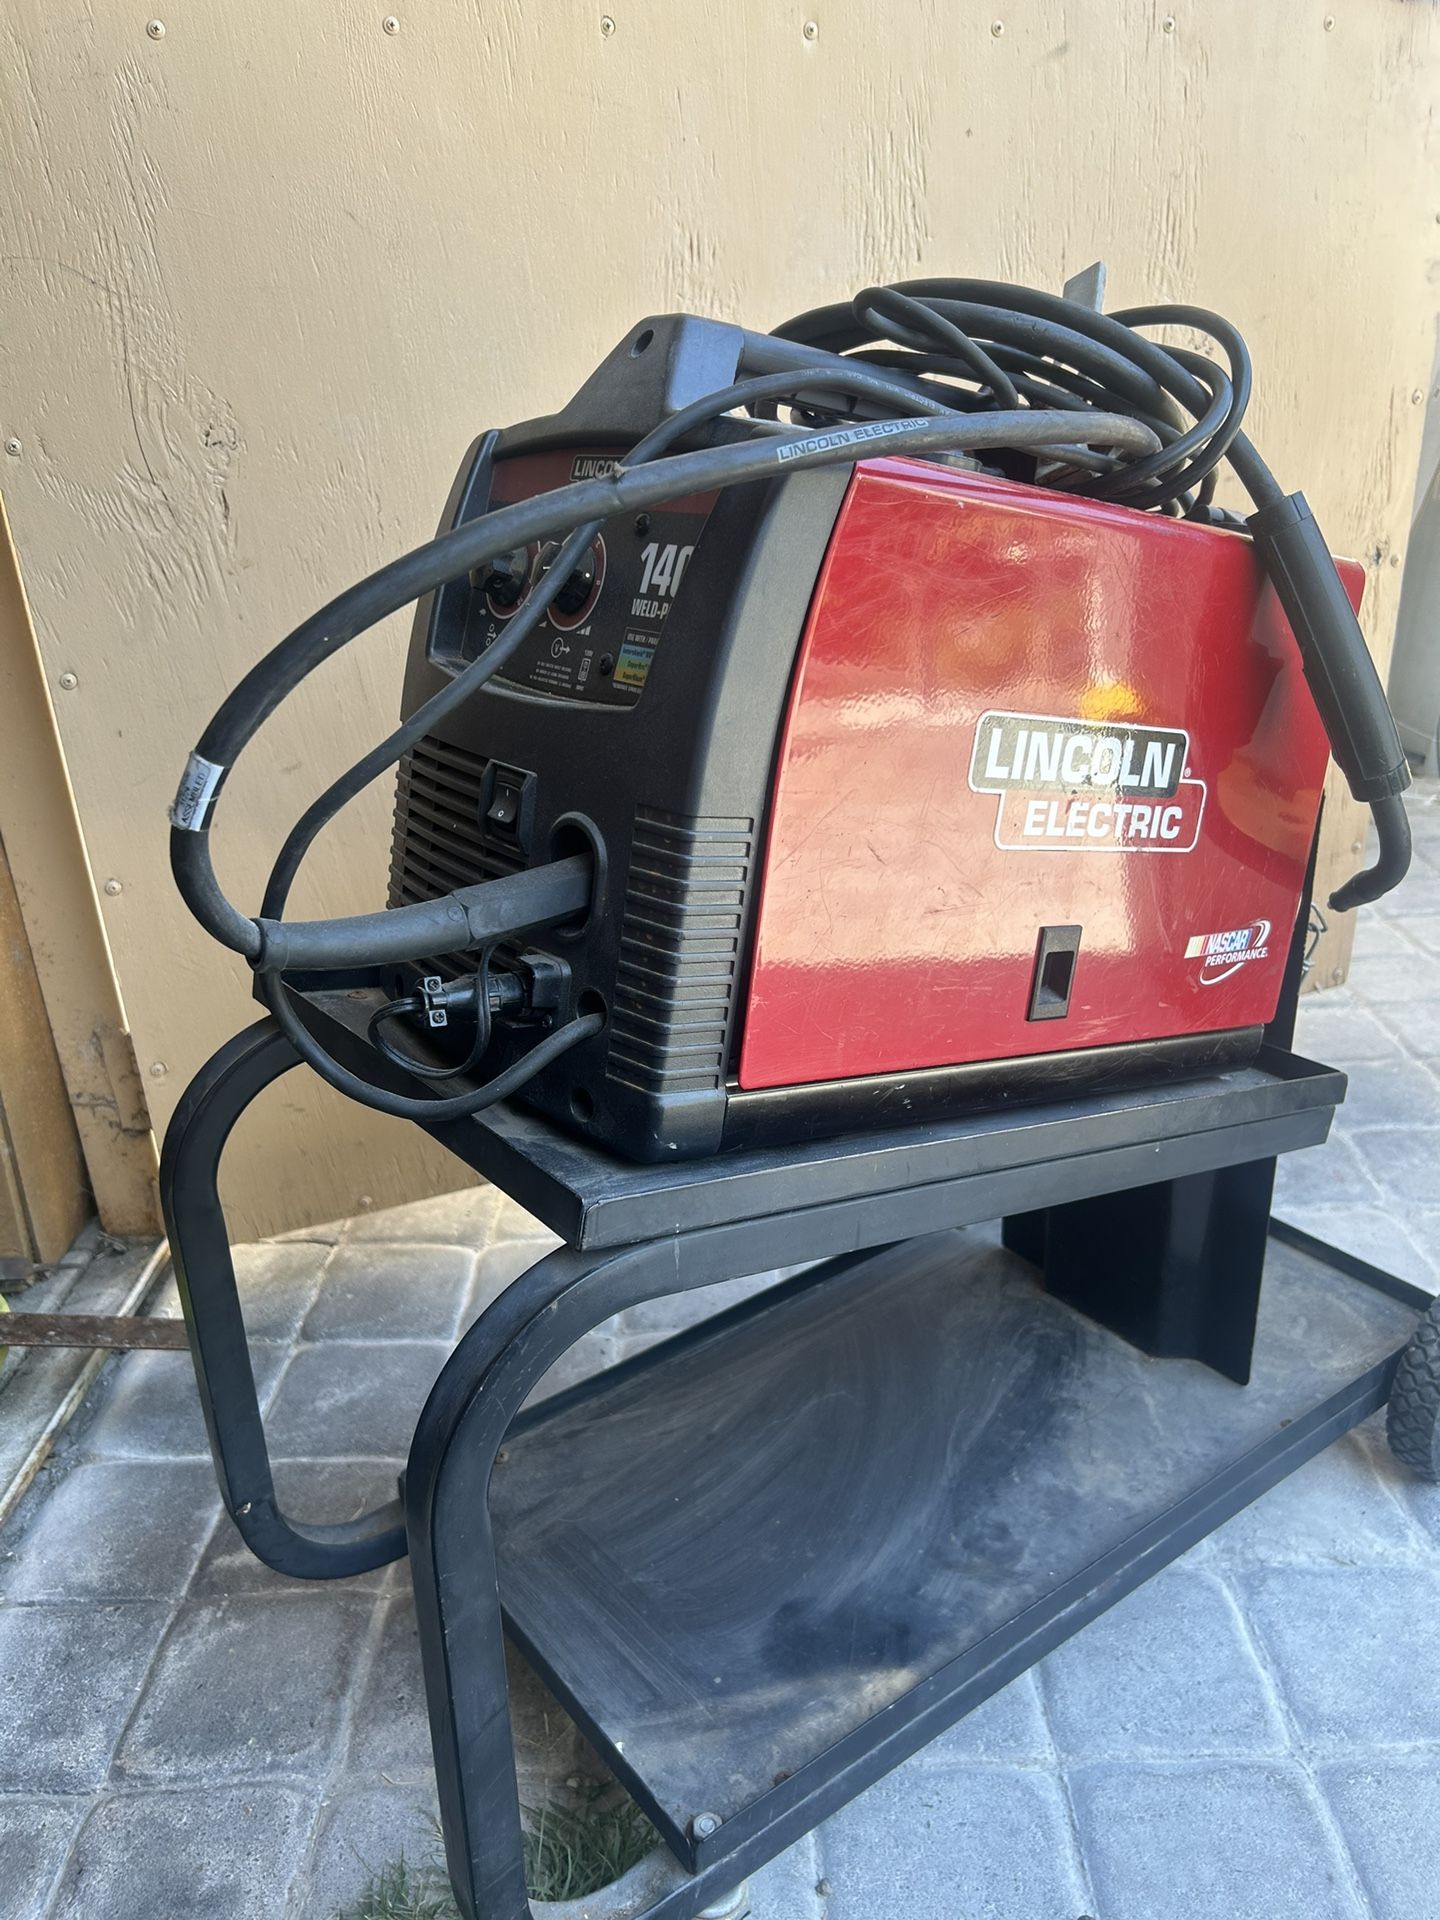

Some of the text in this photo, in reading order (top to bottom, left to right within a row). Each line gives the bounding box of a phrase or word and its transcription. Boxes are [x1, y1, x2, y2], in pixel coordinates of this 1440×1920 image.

[779, 419, 927, 460] LINCOLN ELECTRIC
[574, 459, 615, 479] LINCO
[631, 598, 669, 620] WELD-P
[984, 727, 1176, 789] LINCOLN
[1023, 800, 1183, 840] ELECTRIC
[1206, 929, 1250, 955] NASCAR
[1204, 947, 1268, 967] PERFORMANCE
